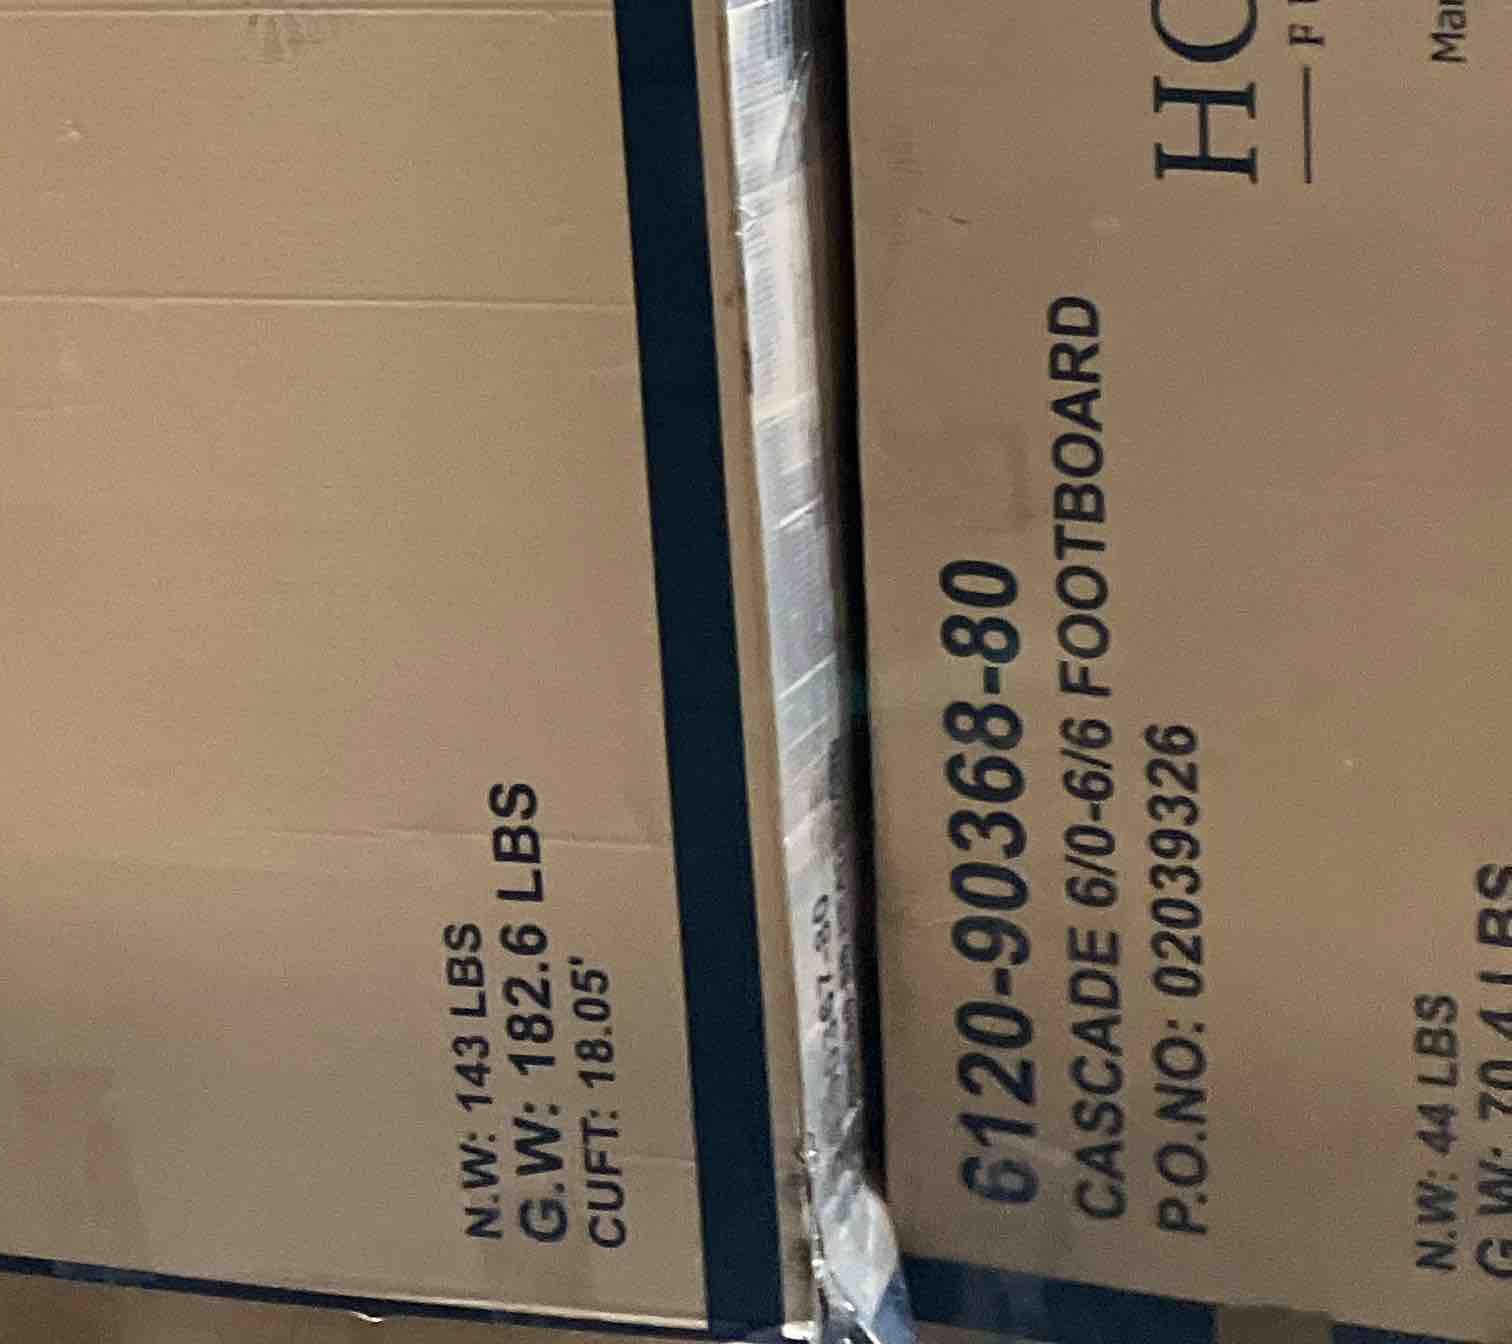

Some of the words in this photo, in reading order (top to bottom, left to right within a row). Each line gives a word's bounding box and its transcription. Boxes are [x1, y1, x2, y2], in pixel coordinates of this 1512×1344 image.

[1047, 295, 1111, 698] FOOTBOARD
[488, 782, 543, 903] LBS
[1058, 717, 1118, 910] 6/0-6/6
[1143, 723, 1203, 998] 02039326
[937, 557, 1038, 1206] 6120-90368-80
[443, 922, 486, 1018] LBS
[498, 923, 556, 1077] 182.6
[569, 955, 614, 1089] 18.05'
[451, 1035, 493, 1113] 143
[1066, 928, 1126, 1222] CASCADE
[1414, 992, 1459, 1088] LBS
[1476, 1008, 1512, 1123] 704
[457, 1132, 502, 1240] N.W:
[512, 1102, 568, 1243] G.W:
[580, 1109, 626, 1249] CUFT:
[1152, 1018, 1208, 1235] P.O.NO:
[1415, 1103, 1458, 1156] 44
[1415, 1170, 1459, 1272] N.W:
[1476, 1145, 1512, 1279] GW:
